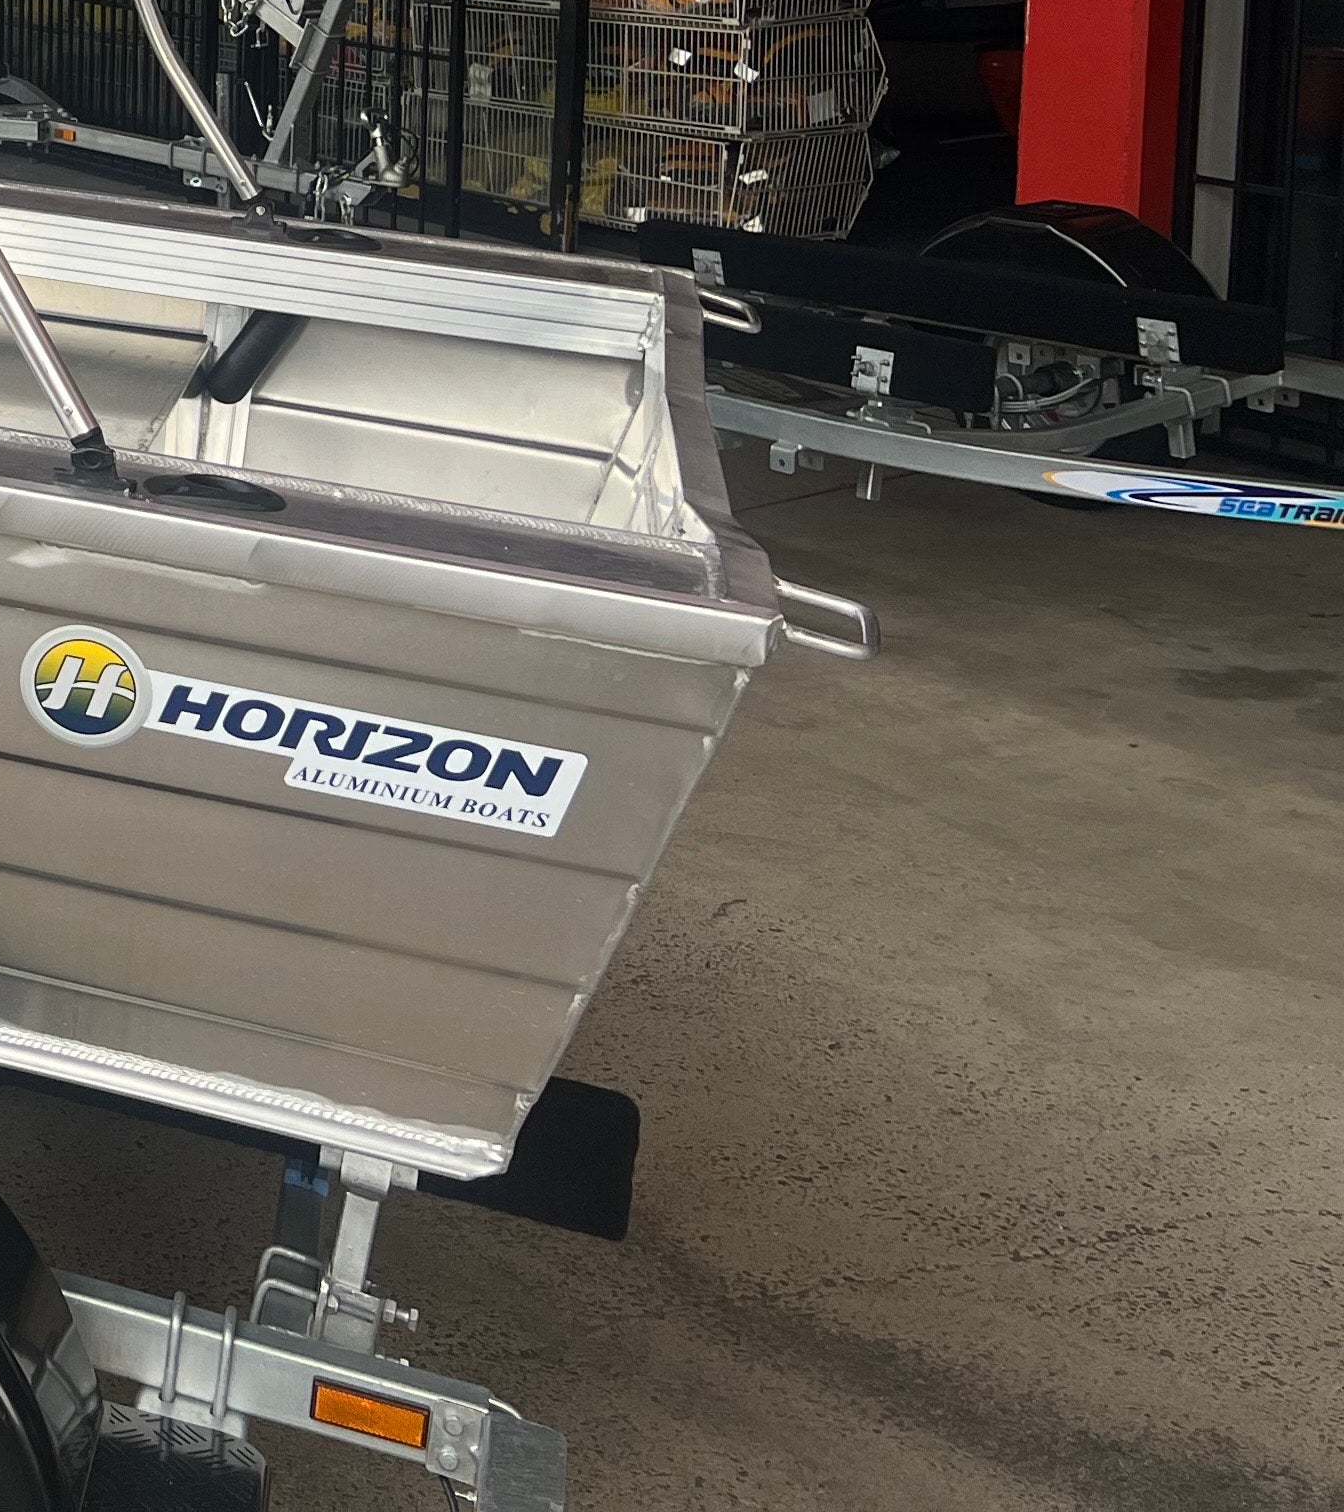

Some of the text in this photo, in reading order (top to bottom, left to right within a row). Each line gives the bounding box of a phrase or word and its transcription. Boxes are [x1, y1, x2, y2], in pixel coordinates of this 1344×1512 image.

[1218, 498, 1344, 524] SEATRAI
[159, 684, 563, 797] HORIZON
[292, 765, 552, 830] ALUMINIUM BOATS
